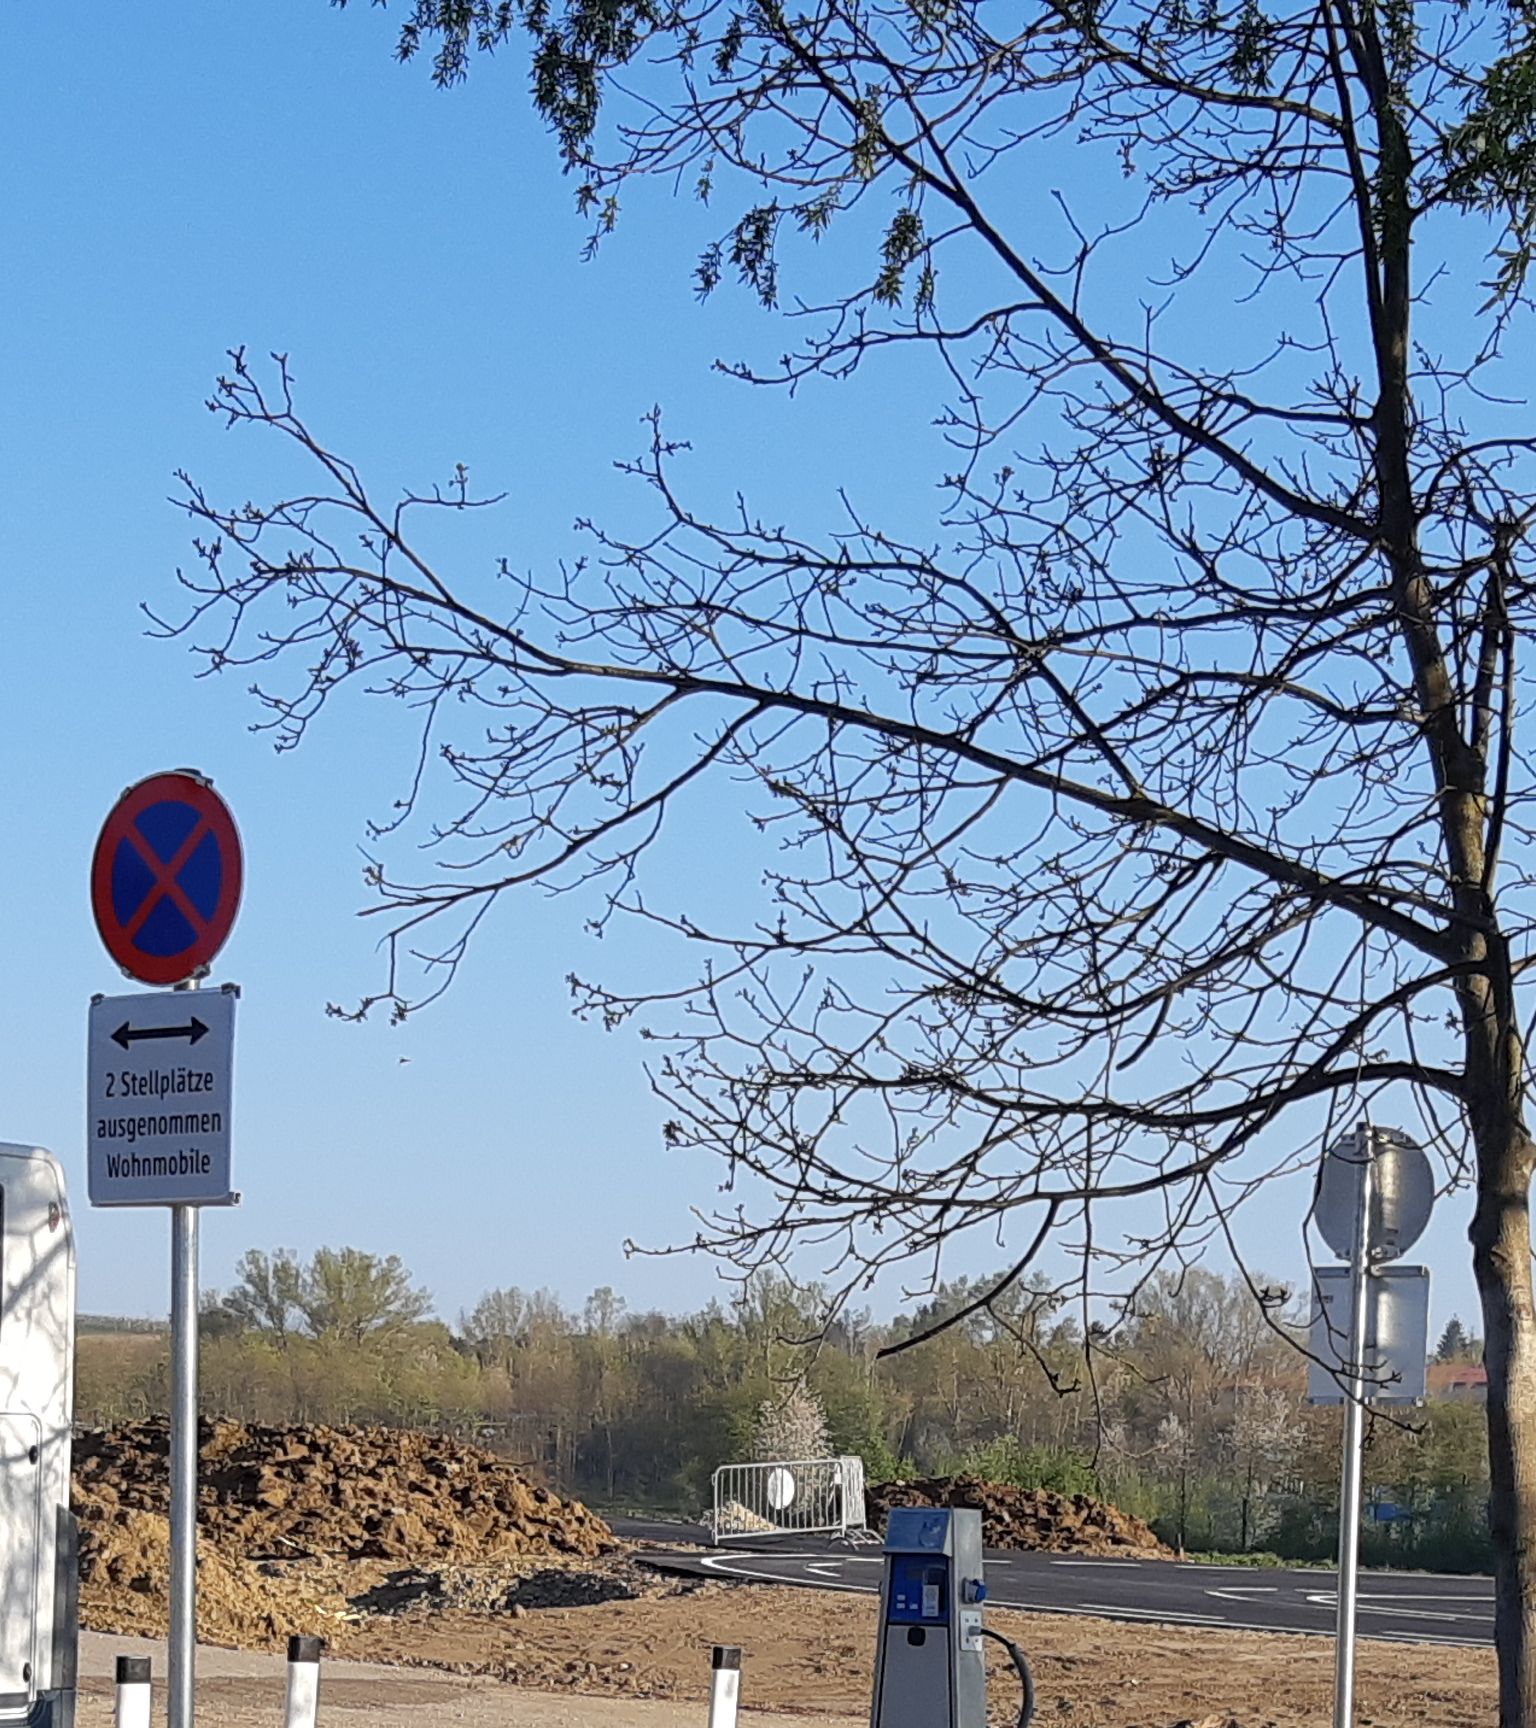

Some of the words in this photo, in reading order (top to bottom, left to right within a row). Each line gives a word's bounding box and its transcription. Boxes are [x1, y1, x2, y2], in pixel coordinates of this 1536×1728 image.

[105, 1072, 115, 1098] 2
[121, 1067, 214, 1100] Stellplätze
[97, 1112, 221, 1143] ausgenommen
[107, 1147, 211, 1178] Wohnmobile
